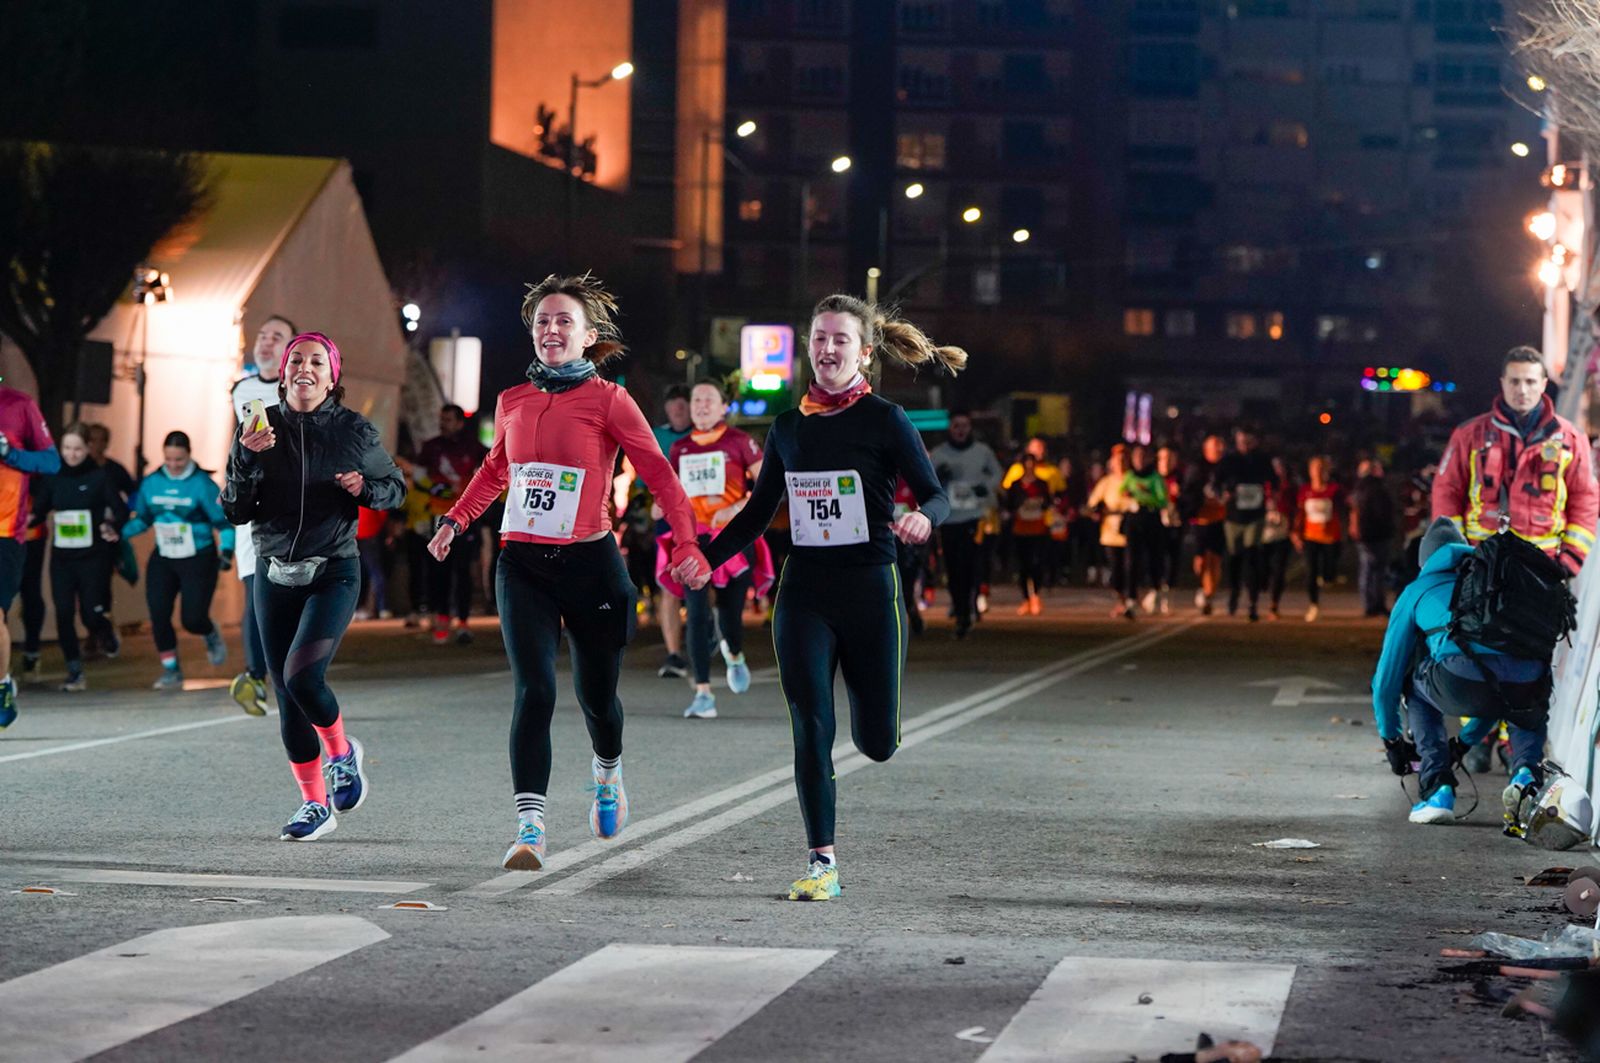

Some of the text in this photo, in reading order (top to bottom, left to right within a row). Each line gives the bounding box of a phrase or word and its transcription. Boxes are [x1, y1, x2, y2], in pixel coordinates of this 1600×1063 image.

[545, 471, 554, 479] DE
[800, 480, 821, 488] NOCHE
[823, 479, 831, 488] DE
[795, 488, 833, 497] SAN ANTÓN
[523, 488, 557, 511] 753
[807, 499, 842, 520] 754
